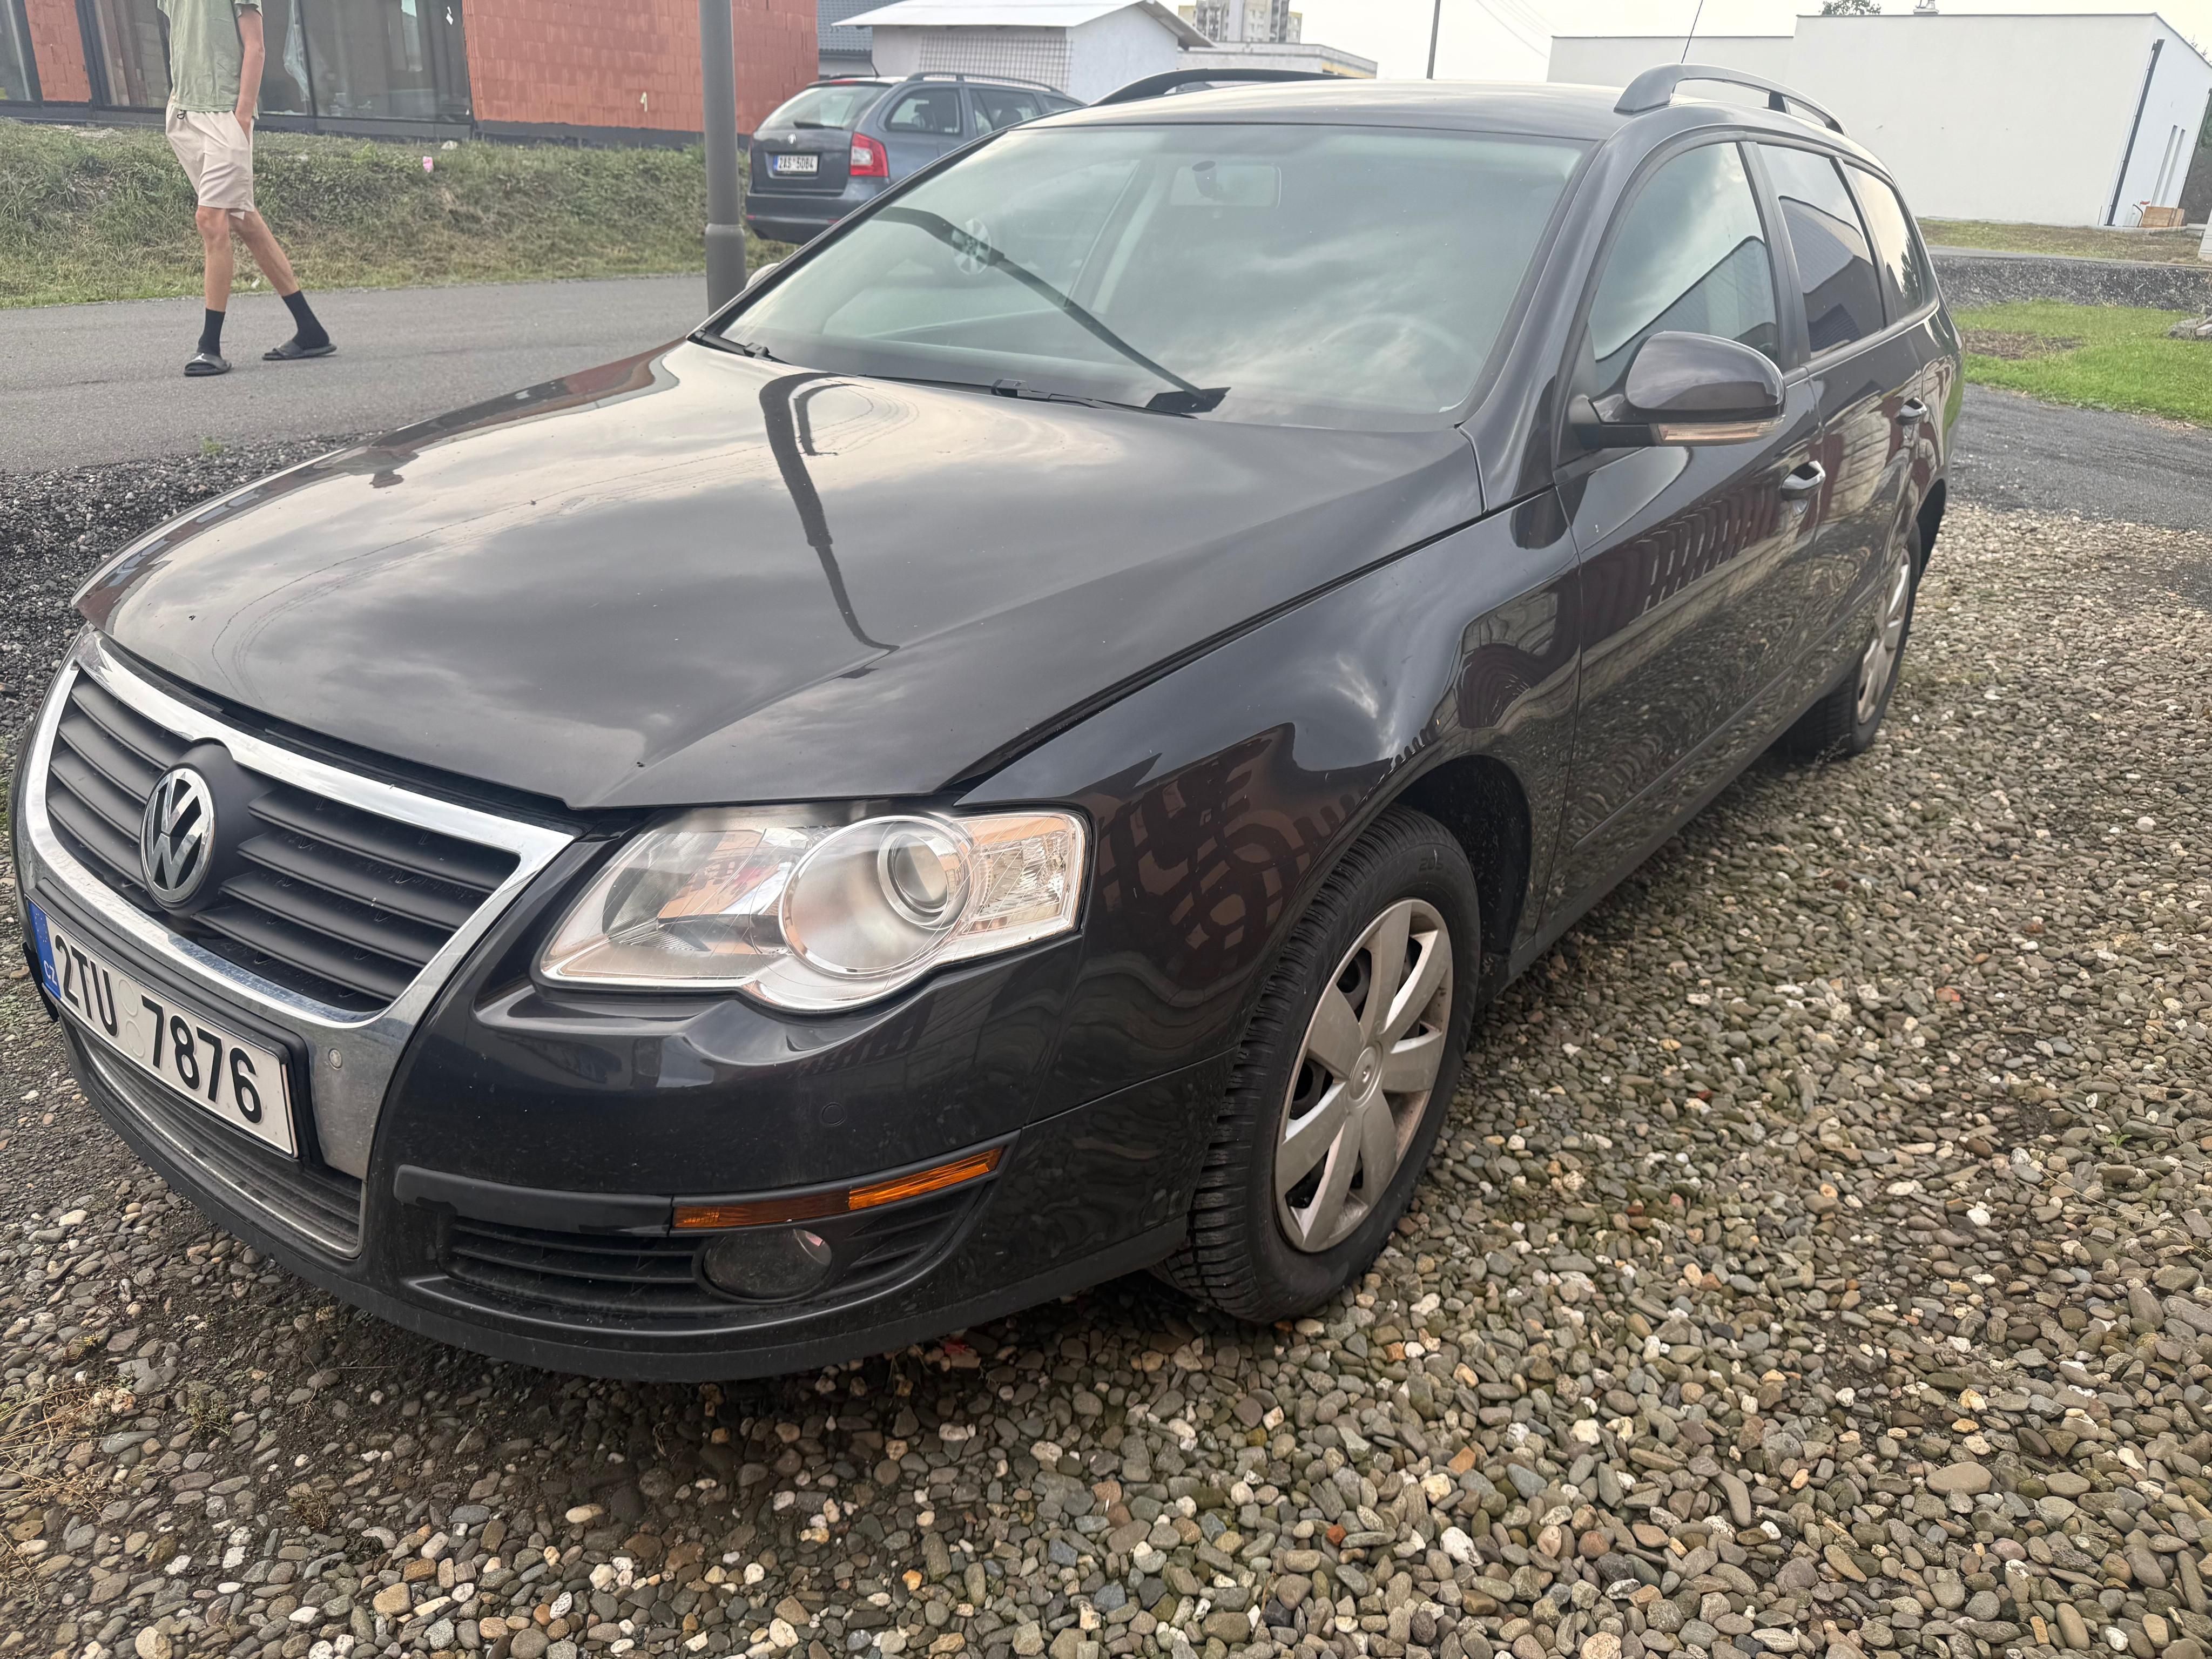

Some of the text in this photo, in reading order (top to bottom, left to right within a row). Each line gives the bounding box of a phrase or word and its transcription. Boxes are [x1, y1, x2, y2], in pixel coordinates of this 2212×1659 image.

[44, 960, 58, 986] CZ
[55, 935, 262, 1124] 2TU 7876
